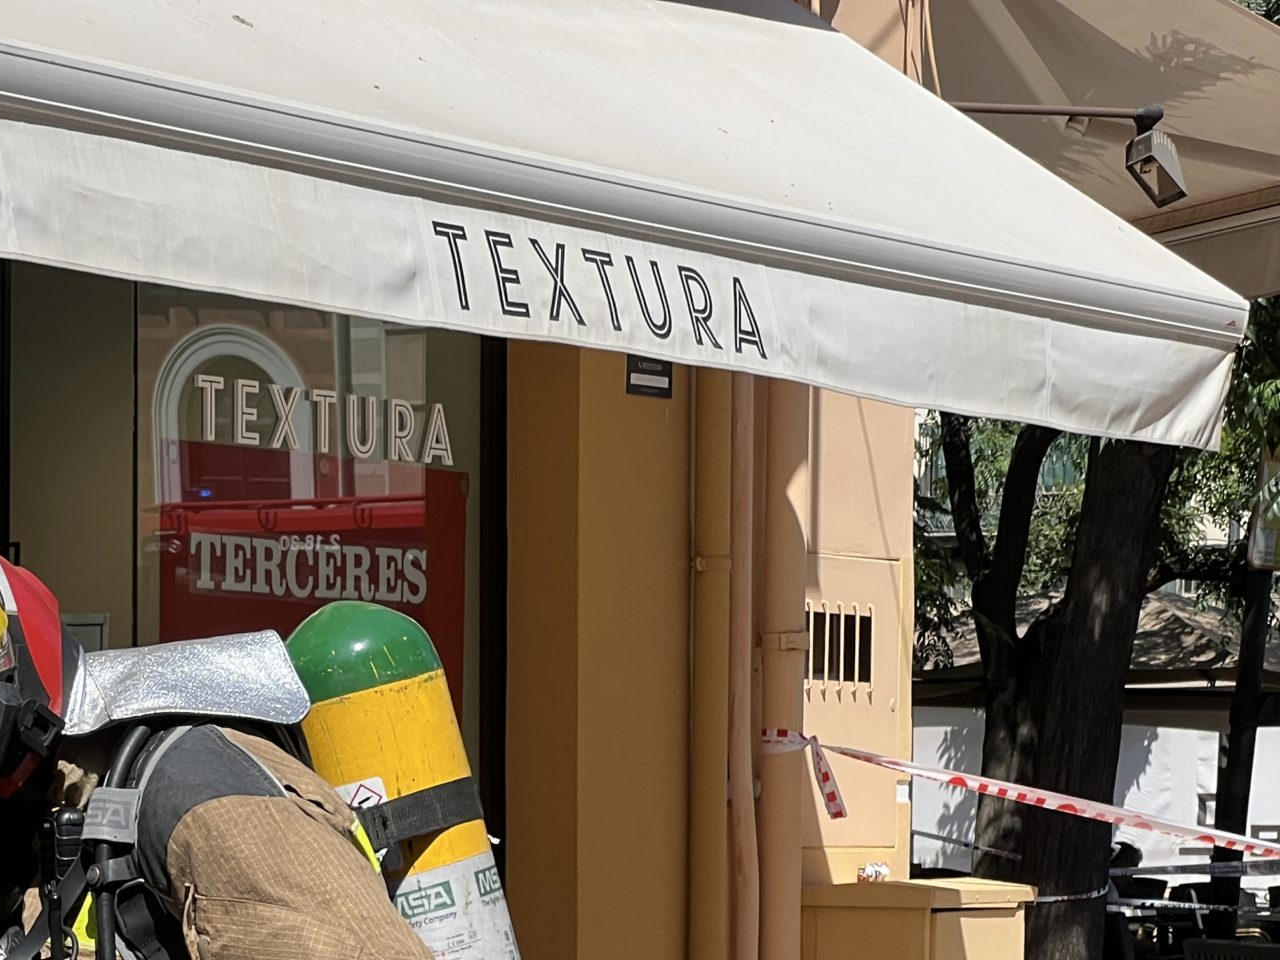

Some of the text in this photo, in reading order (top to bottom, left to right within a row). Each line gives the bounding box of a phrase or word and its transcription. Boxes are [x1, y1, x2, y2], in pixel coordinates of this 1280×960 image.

[432, 220, 768, 360] TEXTURA
[194, 374, 454, 466] TEXTURA
[190, 532, 428, 604] TERCERES
[424, 911, 457, 925] Company
